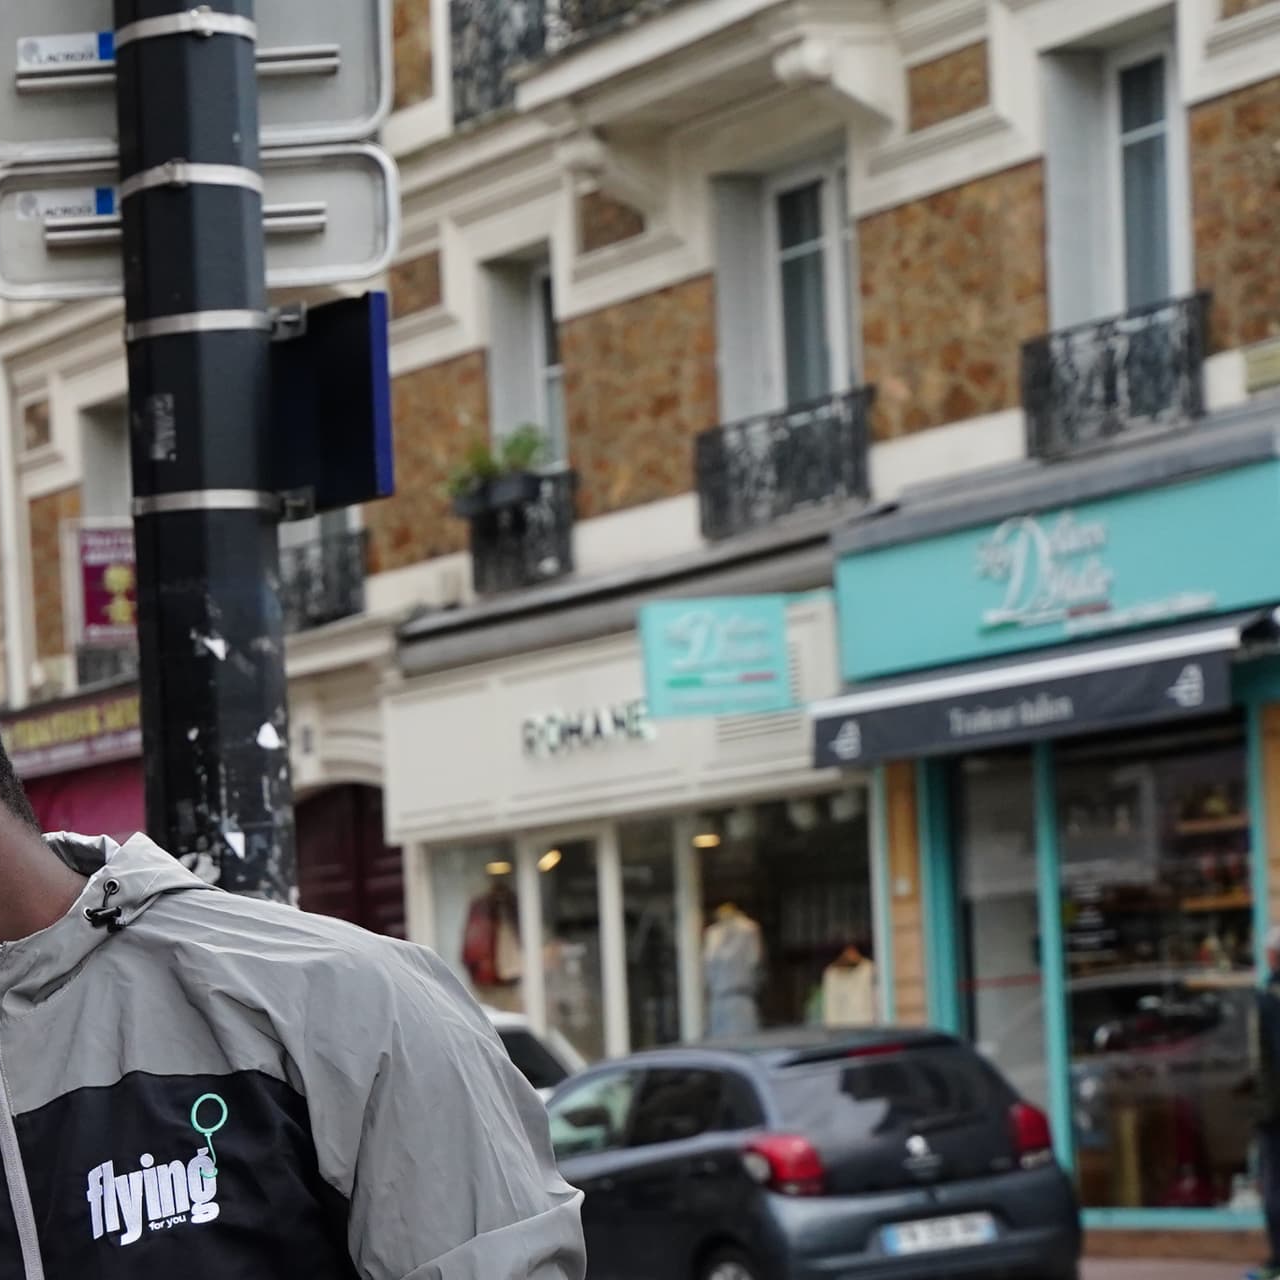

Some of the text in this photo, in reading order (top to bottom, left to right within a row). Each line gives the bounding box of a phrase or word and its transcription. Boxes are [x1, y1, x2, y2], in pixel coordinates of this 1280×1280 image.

[87, 1147, 220, 1246] flying
[148, 1215, 187, 1231] for you
